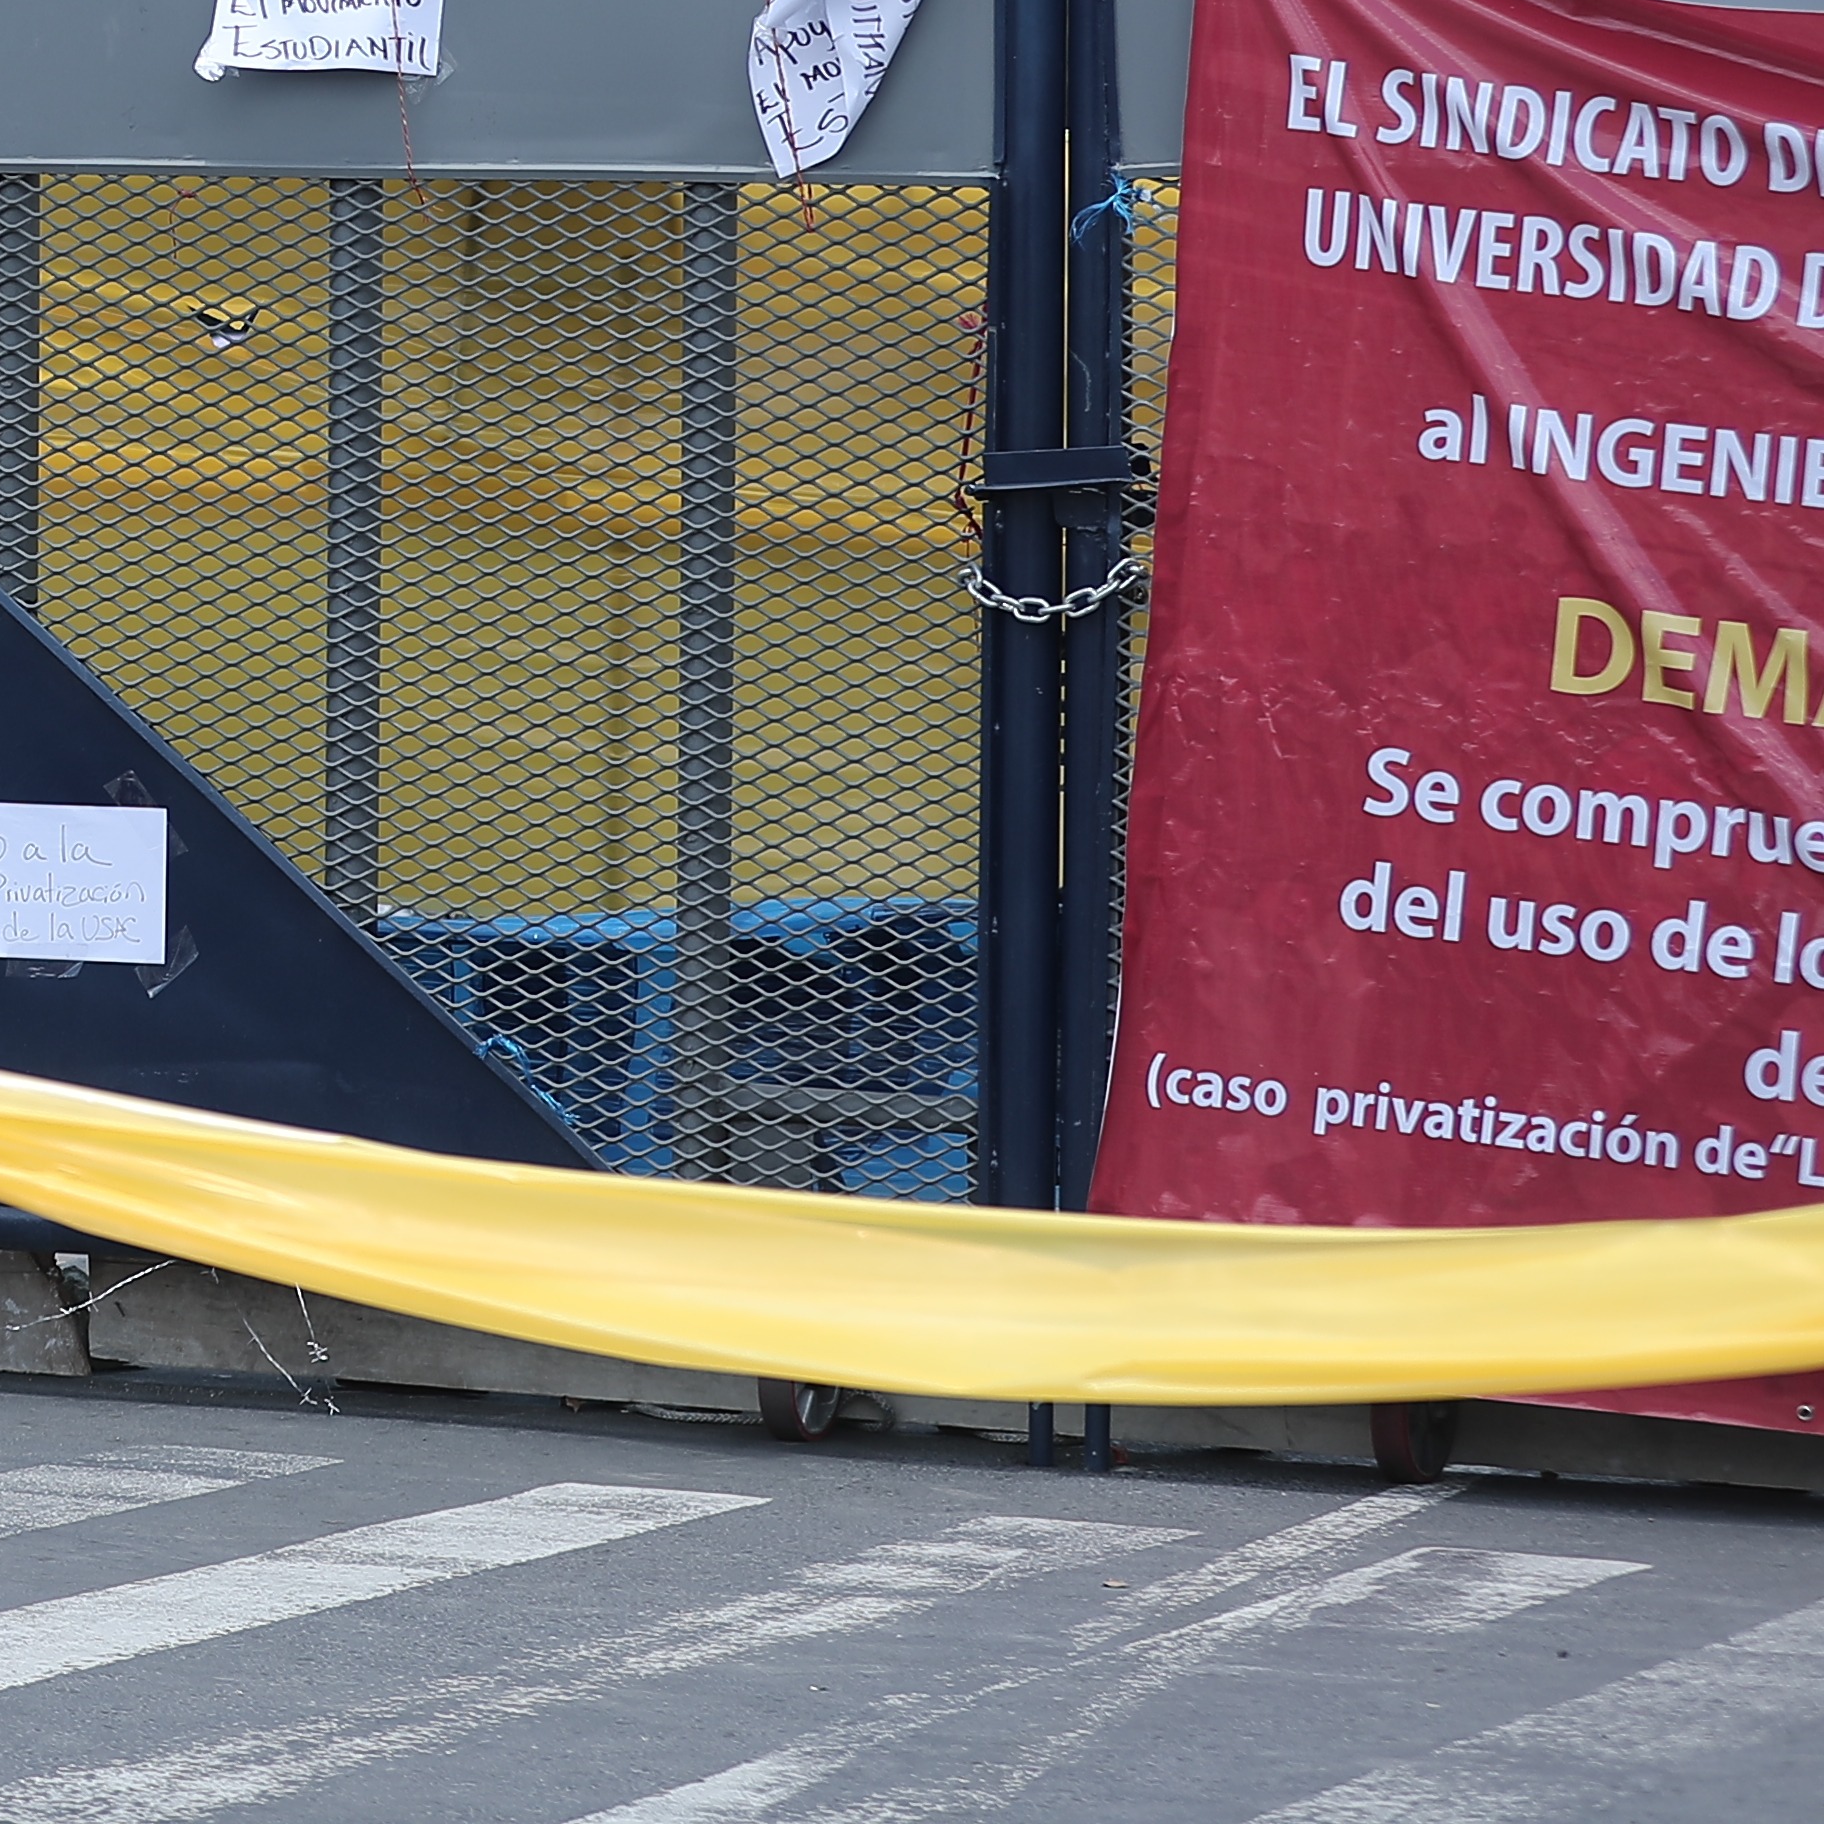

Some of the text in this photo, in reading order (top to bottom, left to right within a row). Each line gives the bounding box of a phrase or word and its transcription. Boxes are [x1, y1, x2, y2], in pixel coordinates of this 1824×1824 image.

[1287, 53, 1358, 139] EL
[1376, 67, 1748, 187] SINDICATO
[1304, 187, 1779, 322] UNIVERSIDAD
[1417, 392, 1488, 465] al
[1550, 596, 1824, 729] DEM
[1363, 745, 1460, 824] Se
[22, 843, 48, 861] a
[60, 824, 113, 866] la
[2, 911, 141, 944] de la USAC
[1339, 861, 1467, 943] del
[1487, 896, 1631, 963] uso
[1651, 899, 1756, 979] de
[1146, 1052, 1288, 1117] (caso
[1312, 1080, 1679, 1170] privatización
